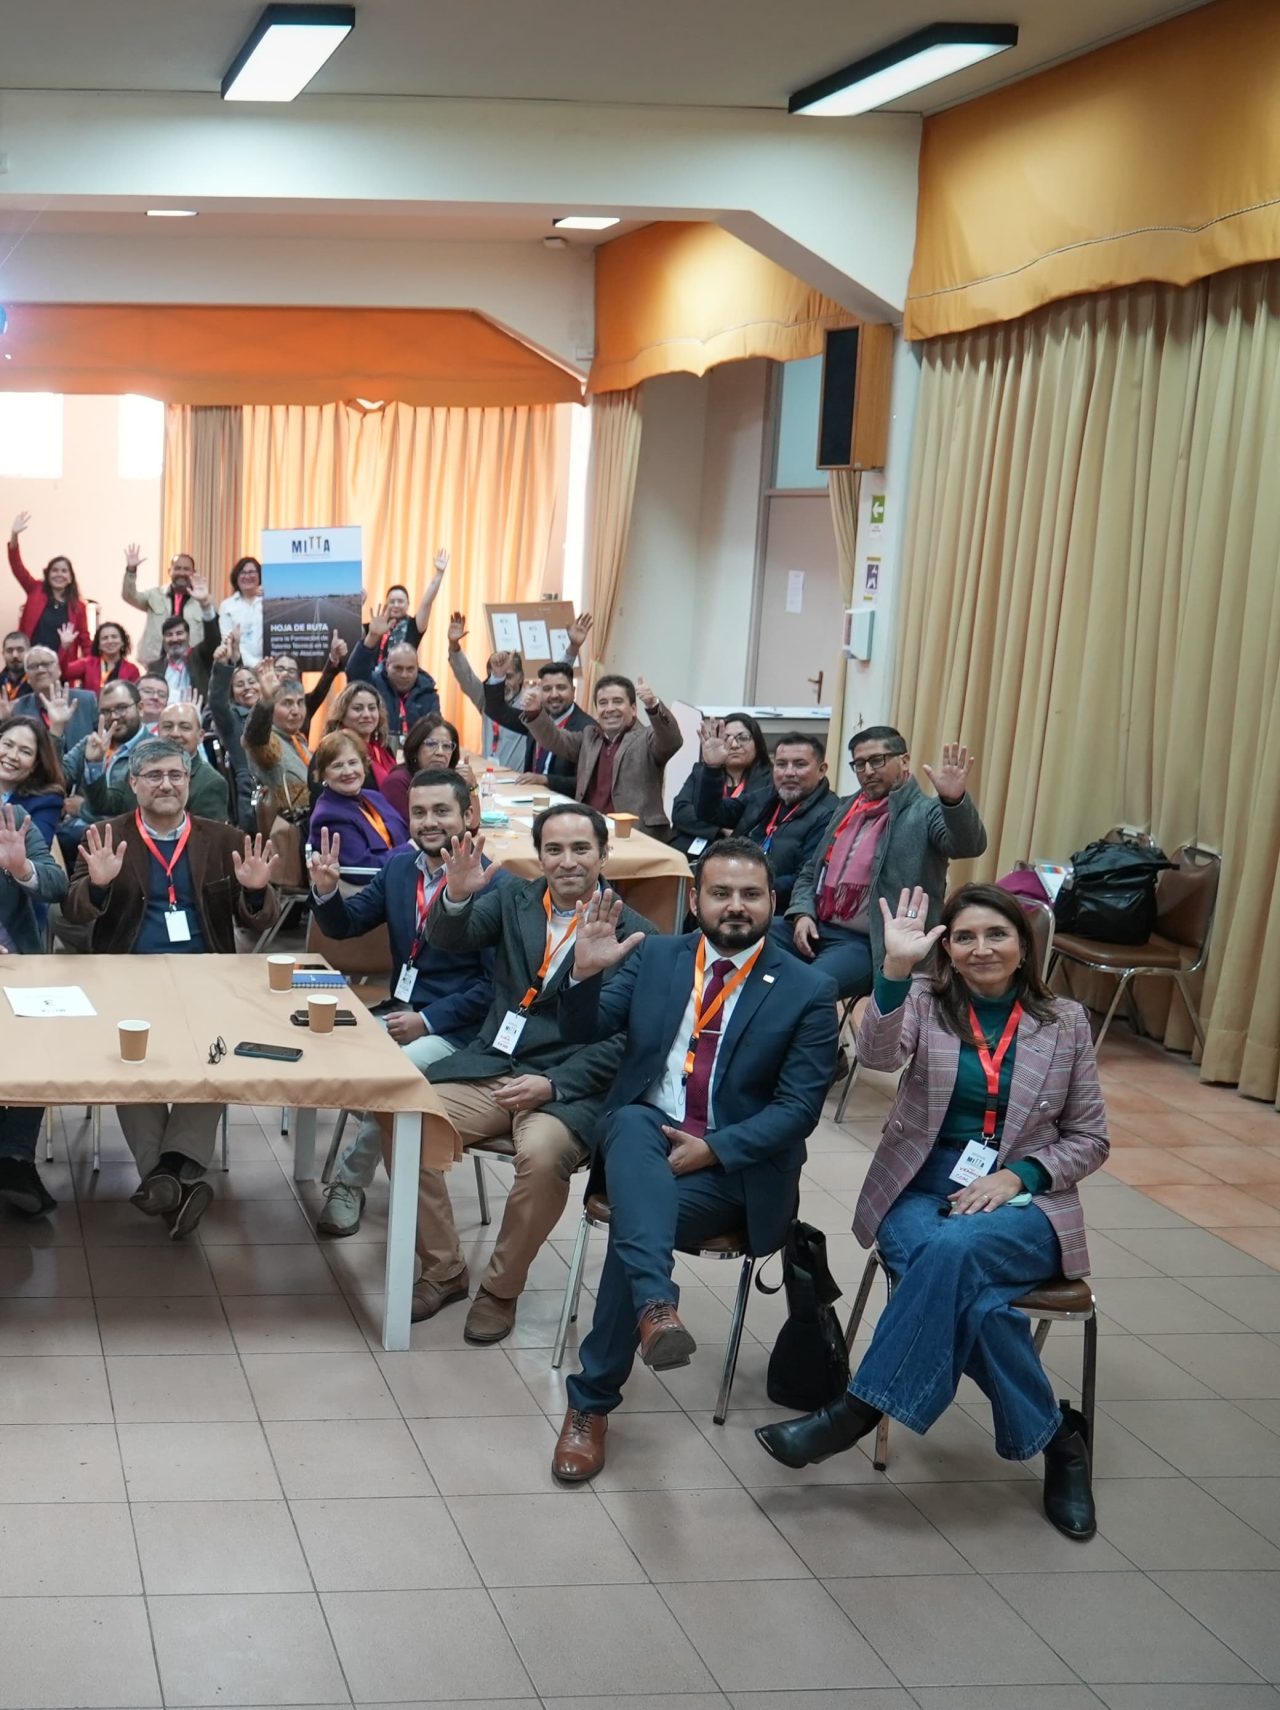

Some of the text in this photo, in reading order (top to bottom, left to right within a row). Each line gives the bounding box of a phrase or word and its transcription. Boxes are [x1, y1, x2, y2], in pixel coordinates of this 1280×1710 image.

[292, 536, 331, 553] MITTA
[270, 624, 293, 632] HOJA
[306, 623, 329, 631] RUTA
